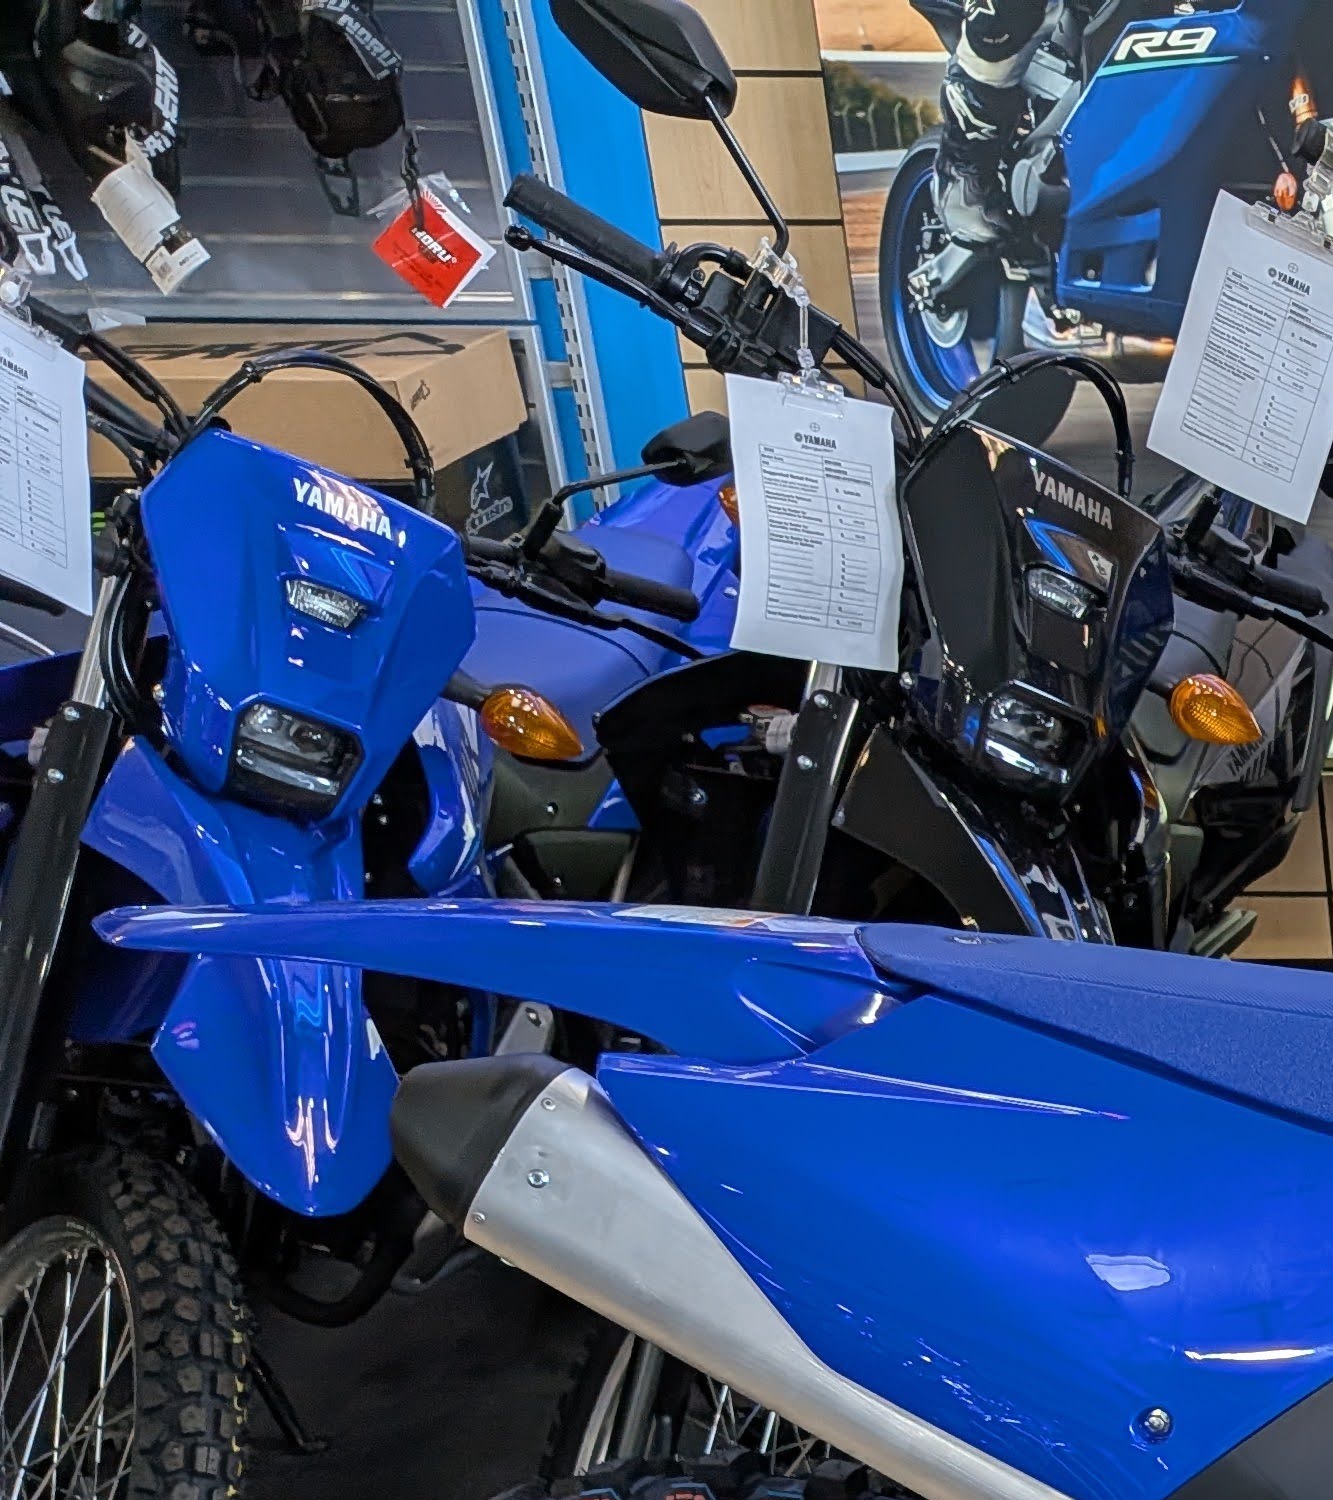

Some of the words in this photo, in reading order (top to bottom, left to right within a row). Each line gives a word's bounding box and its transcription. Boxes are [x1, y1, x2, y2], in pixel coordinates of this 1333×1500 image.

[1114, 26, 1217, 61] R9
[1277, 272, 1311, 295] YAMAHA
[803, 434, 837, 450] YAMAHA
[293, 477, 394, 541] YAMAHA
[1031, 466, 1113, 531] YAMAHA
